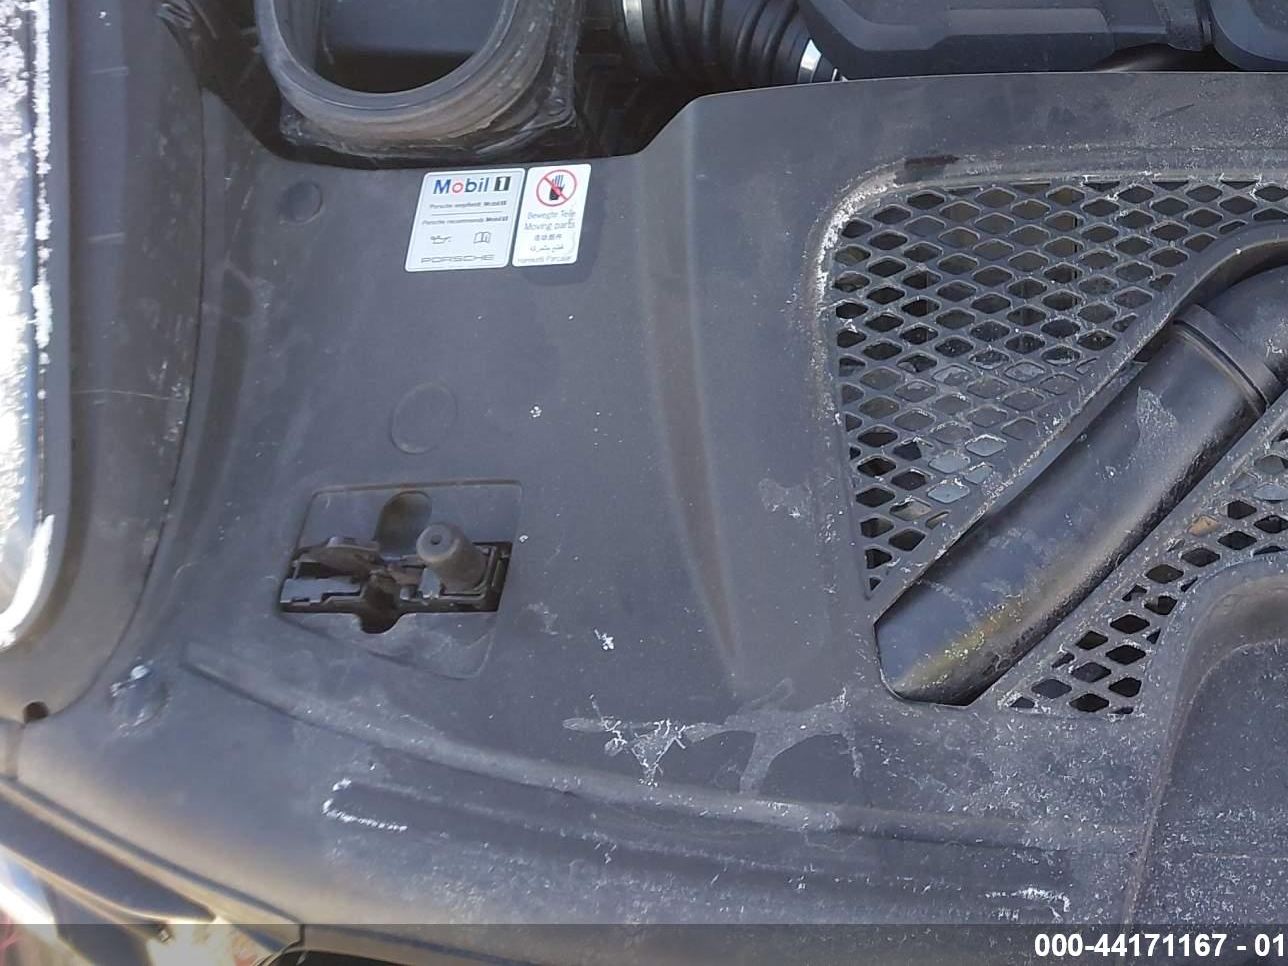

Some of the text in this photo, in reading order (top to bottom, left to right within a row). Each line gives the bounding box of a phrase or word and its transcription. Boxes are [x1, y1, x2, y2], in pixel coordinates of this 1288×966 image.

[433, 176, 512, 195] Mobil 1
[524, 218, 577, 232] Moving parts
[420, 254, 496, 263] PORSCHE
